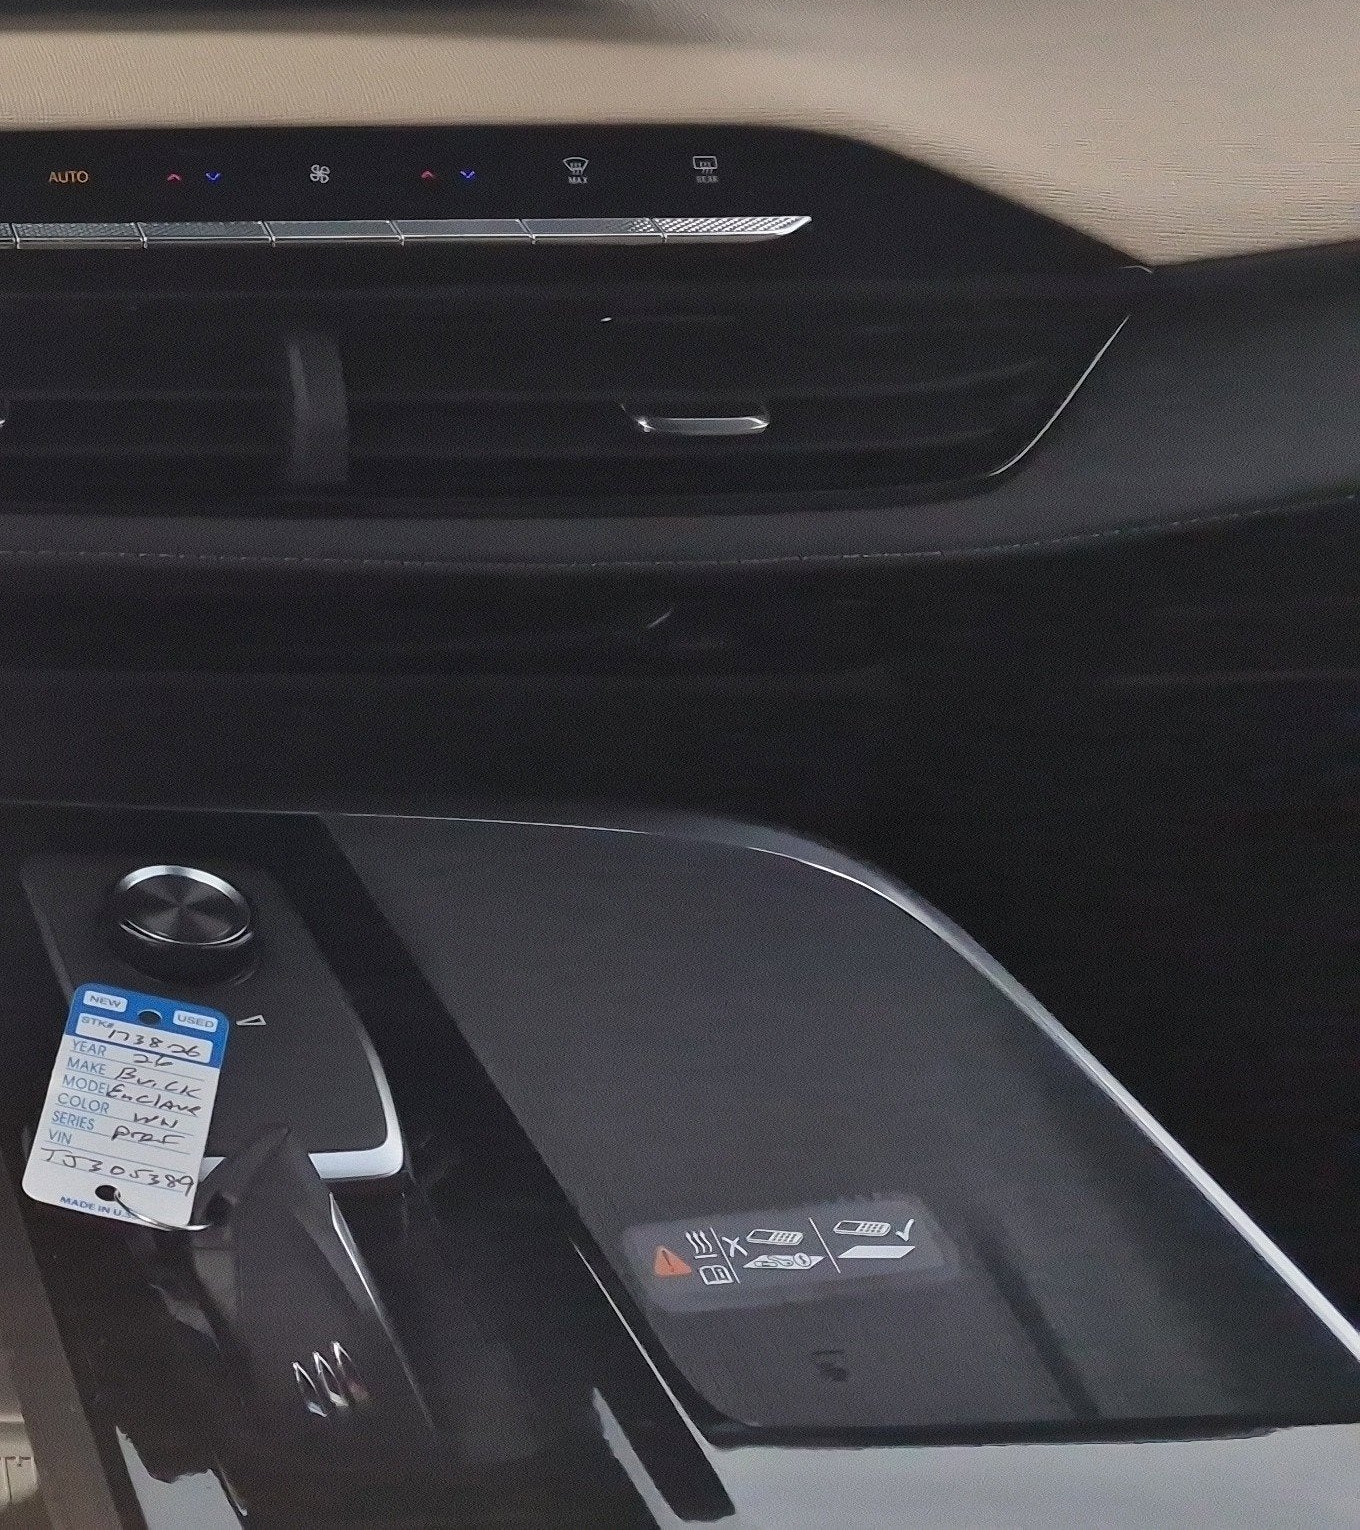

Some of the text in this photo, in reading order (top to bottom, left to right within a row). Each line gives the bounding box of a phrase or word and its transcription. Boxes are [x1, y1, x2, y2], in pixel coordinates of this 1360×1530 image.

[48, 170, 89, 184] AUTO
[568, 176, 588, 185] MAX
[89, 994, 122, 1009] NEW
[81, 1015, 114, 1030] STK#
[177, 1014, 215, 1029] USED
[72, 1038, 107, 1056] YEAR
[66, 1056, 107, 1076] MAKE
[133, 1053, 173, 1067] 26
[57, 1092, 110, 1114] COLOR
[51, 1110, 96, 1131] SERIES
[48, 1129, 72, 1146] VIN
[59, 1195, 96, 1212] MADE
[97, 1203, 112, 1215] IN
